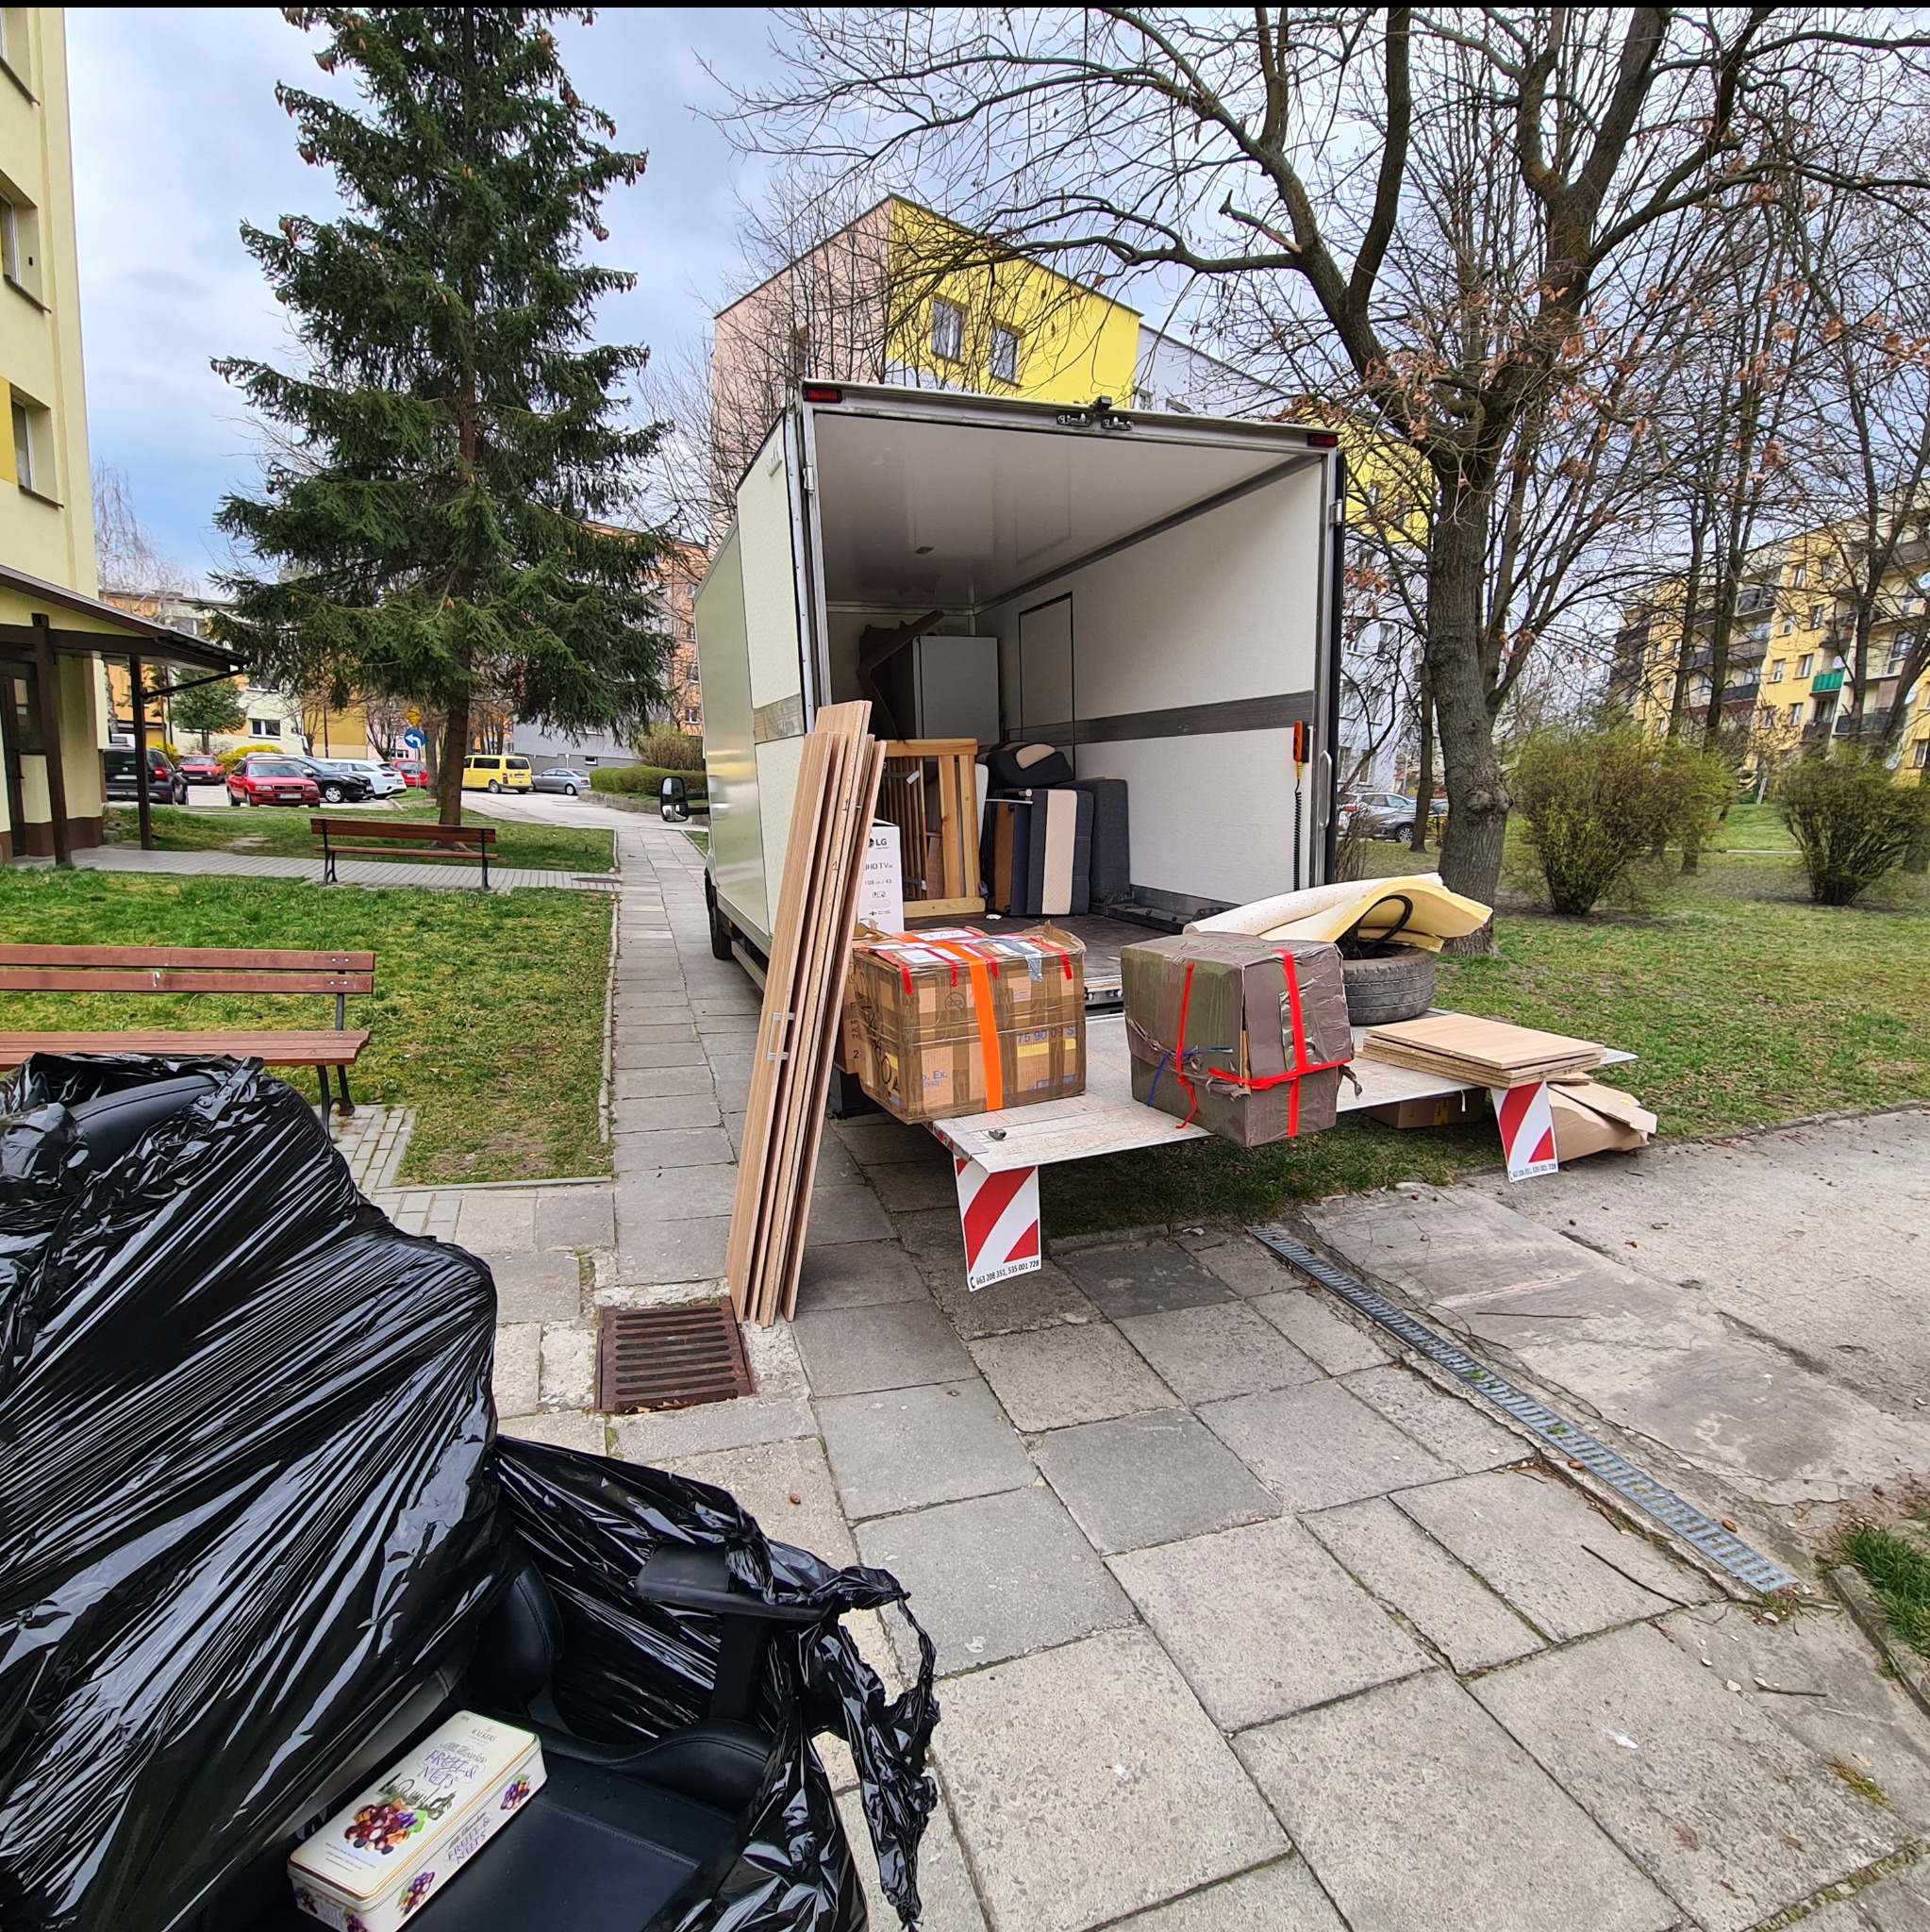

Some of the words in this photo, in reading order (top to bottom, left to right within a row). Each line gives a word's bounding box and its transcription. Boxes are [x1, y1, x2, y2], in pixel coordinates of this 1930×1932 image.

[875, 838, 887, 846] LG
[1019, 1032, 1030, 1042] 75
[1034, 1029, 1047, 1041] 90
[853, 1049, 859, 1058] 2
[933, 1070, 948, 1079] Ex.
[987, 1272, 995, 1281] 208
[1008, 1265, 1018, 1274] 535
[1019, 1262, 1028, 1271] 001
[1029, 1259, 1040, 1268] 728
